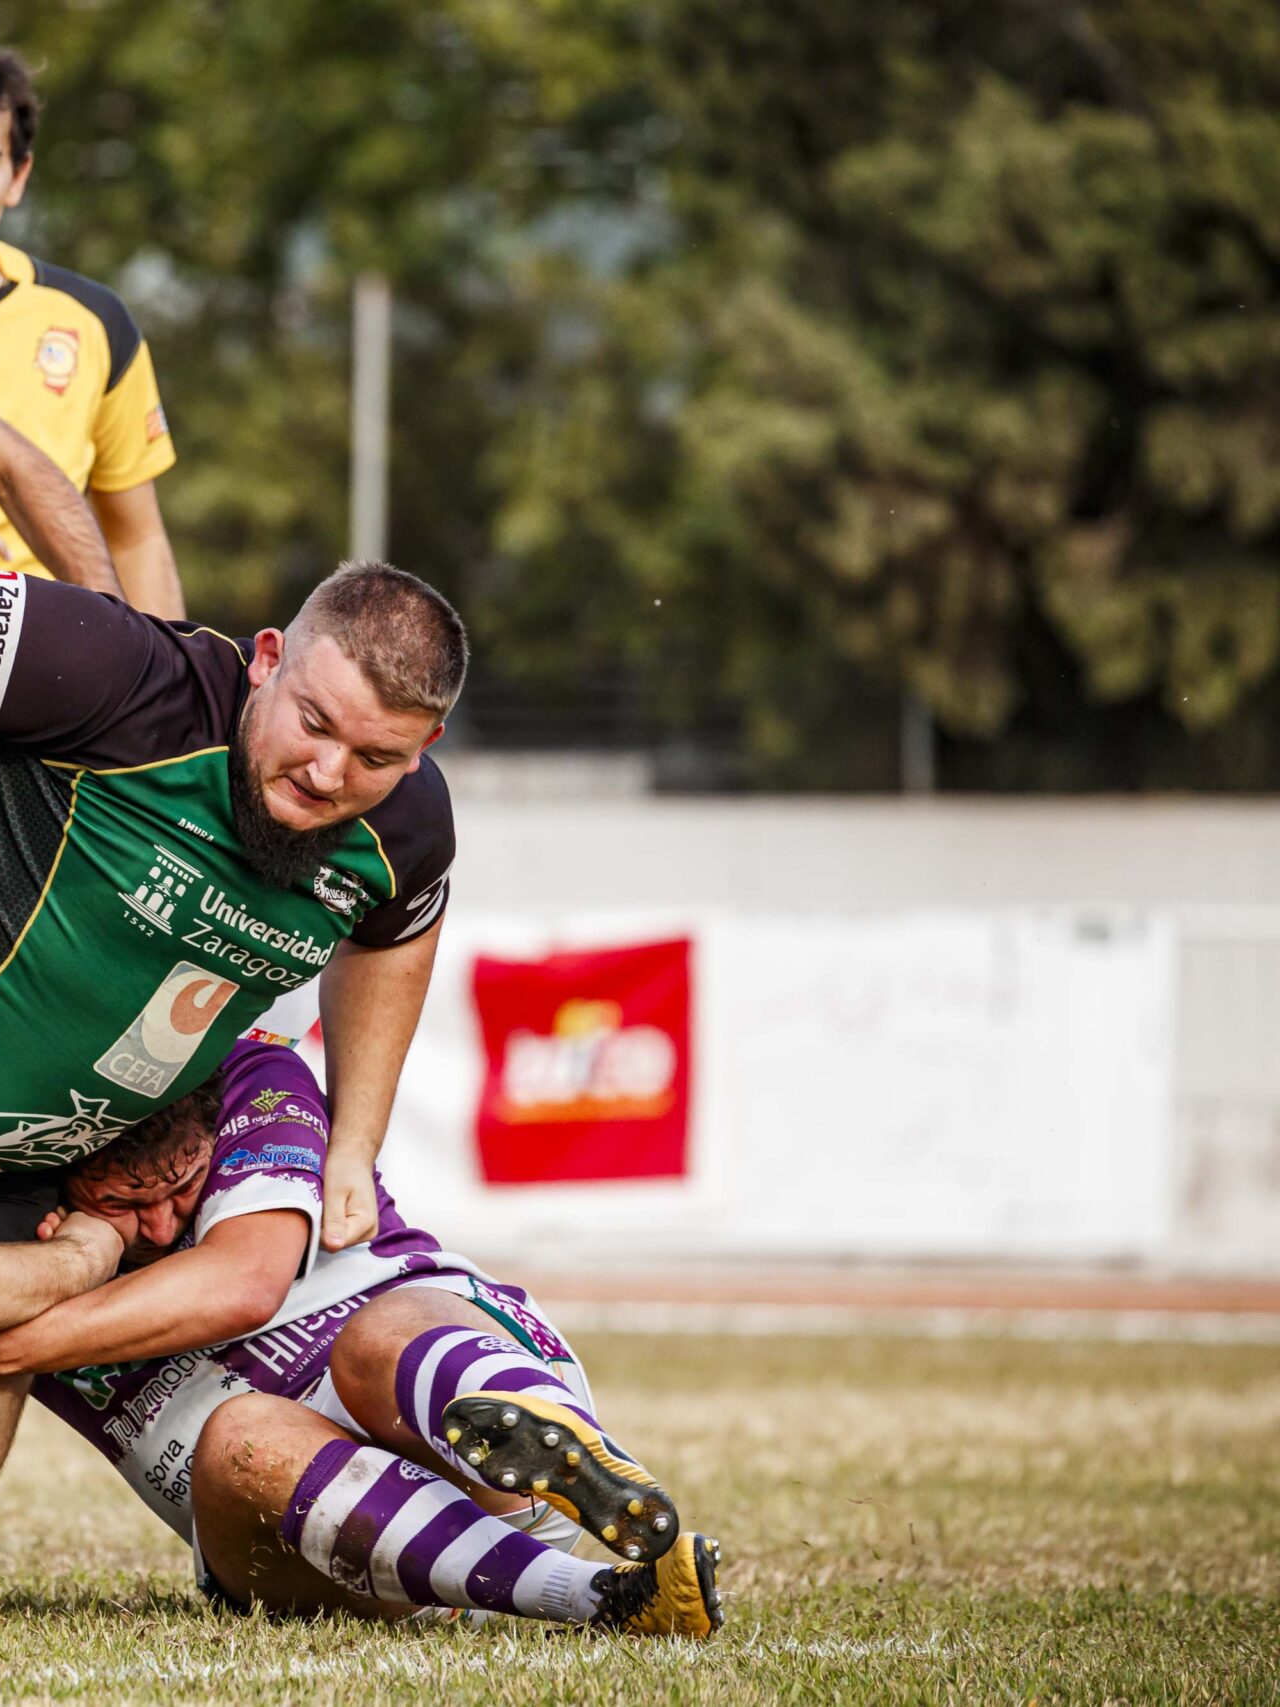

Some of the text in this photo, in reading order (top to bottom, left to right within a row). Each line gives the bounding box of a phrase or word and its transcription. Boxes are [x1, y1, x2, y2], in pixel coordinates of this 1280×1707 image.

[177, 817, 215, 843] AMURA
[122, 909, 156, 939] 1542
[199, 884, 335, 967] Universidad
[108, 1053, 166, 1092] CEFA
[219, 1114, 250, 1138] aja
[286, 1334, 335, 1383] ALUMINIOS
[104, 1416, 135, 1446] Tu
[145, 1439, 185, 1492] Soria
